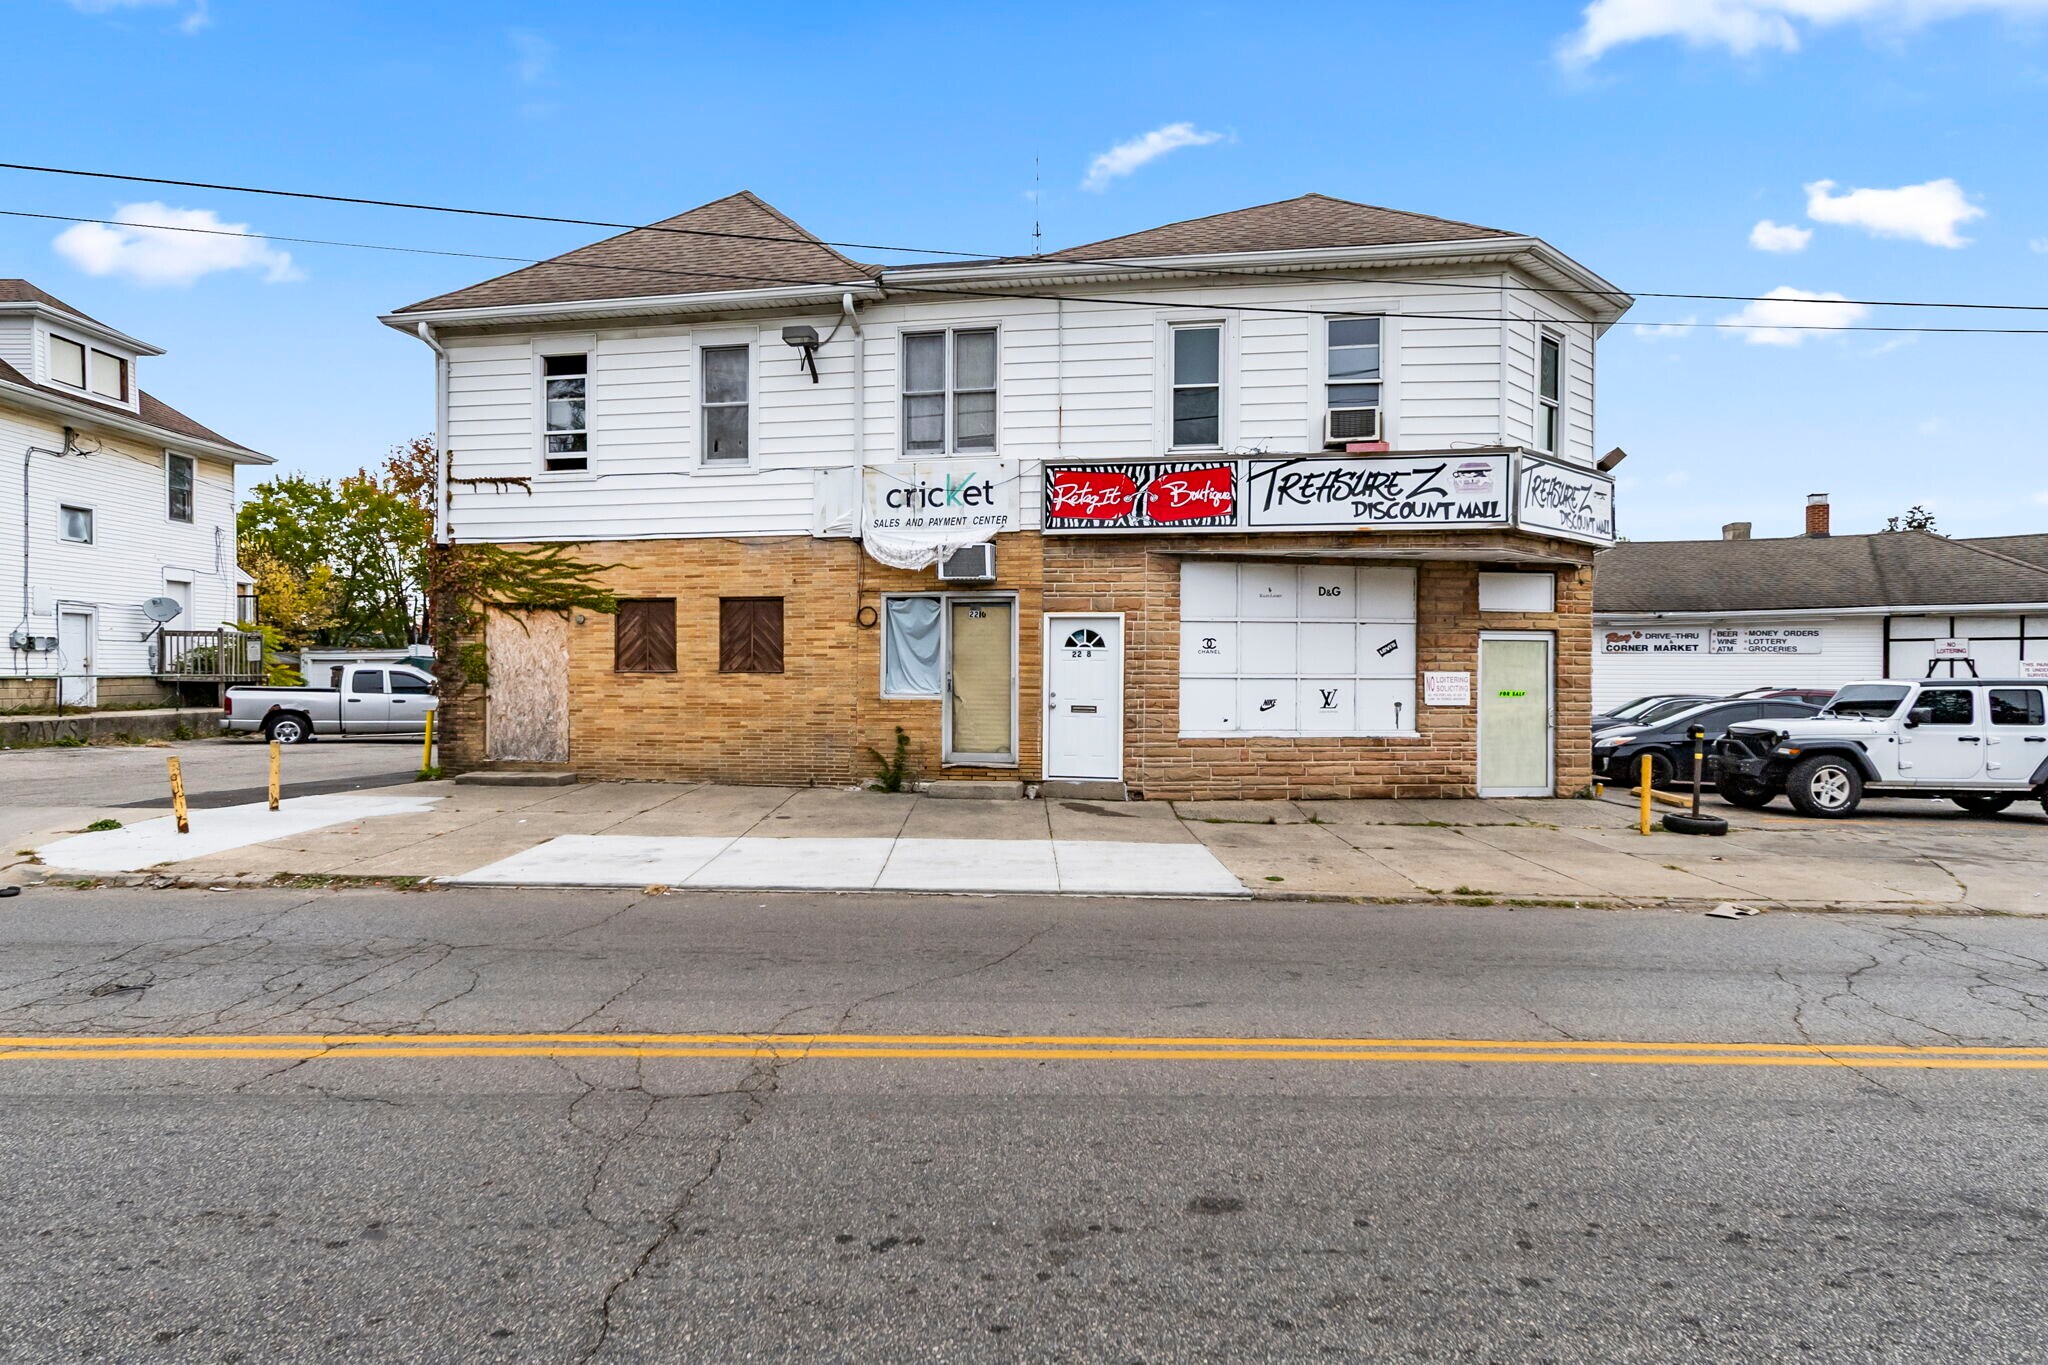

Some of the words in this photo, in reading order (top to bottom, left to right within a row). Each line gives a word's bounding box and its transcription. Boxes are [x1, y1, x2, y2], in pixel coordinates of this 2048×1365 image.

[886, 472, 995, 509] cricket
[1161, 480, 1232, 508] Boutique
[1351, 501, 1455, 520] DISCOUNT
[1456, 500, 1501, 520] MALL
[873, 518, 900, 528] SALES
[905, 517, 924, 527] AND
[928, 516, 968, 527] PAYMENT
[972, 515, 1008, 525] CENTER
[1559, 509, 1596, 534] DISCOUNT
[1318, 586, 1341, 597] D&G
[1645, 632, 1700, 640] DRIVE-THRU
